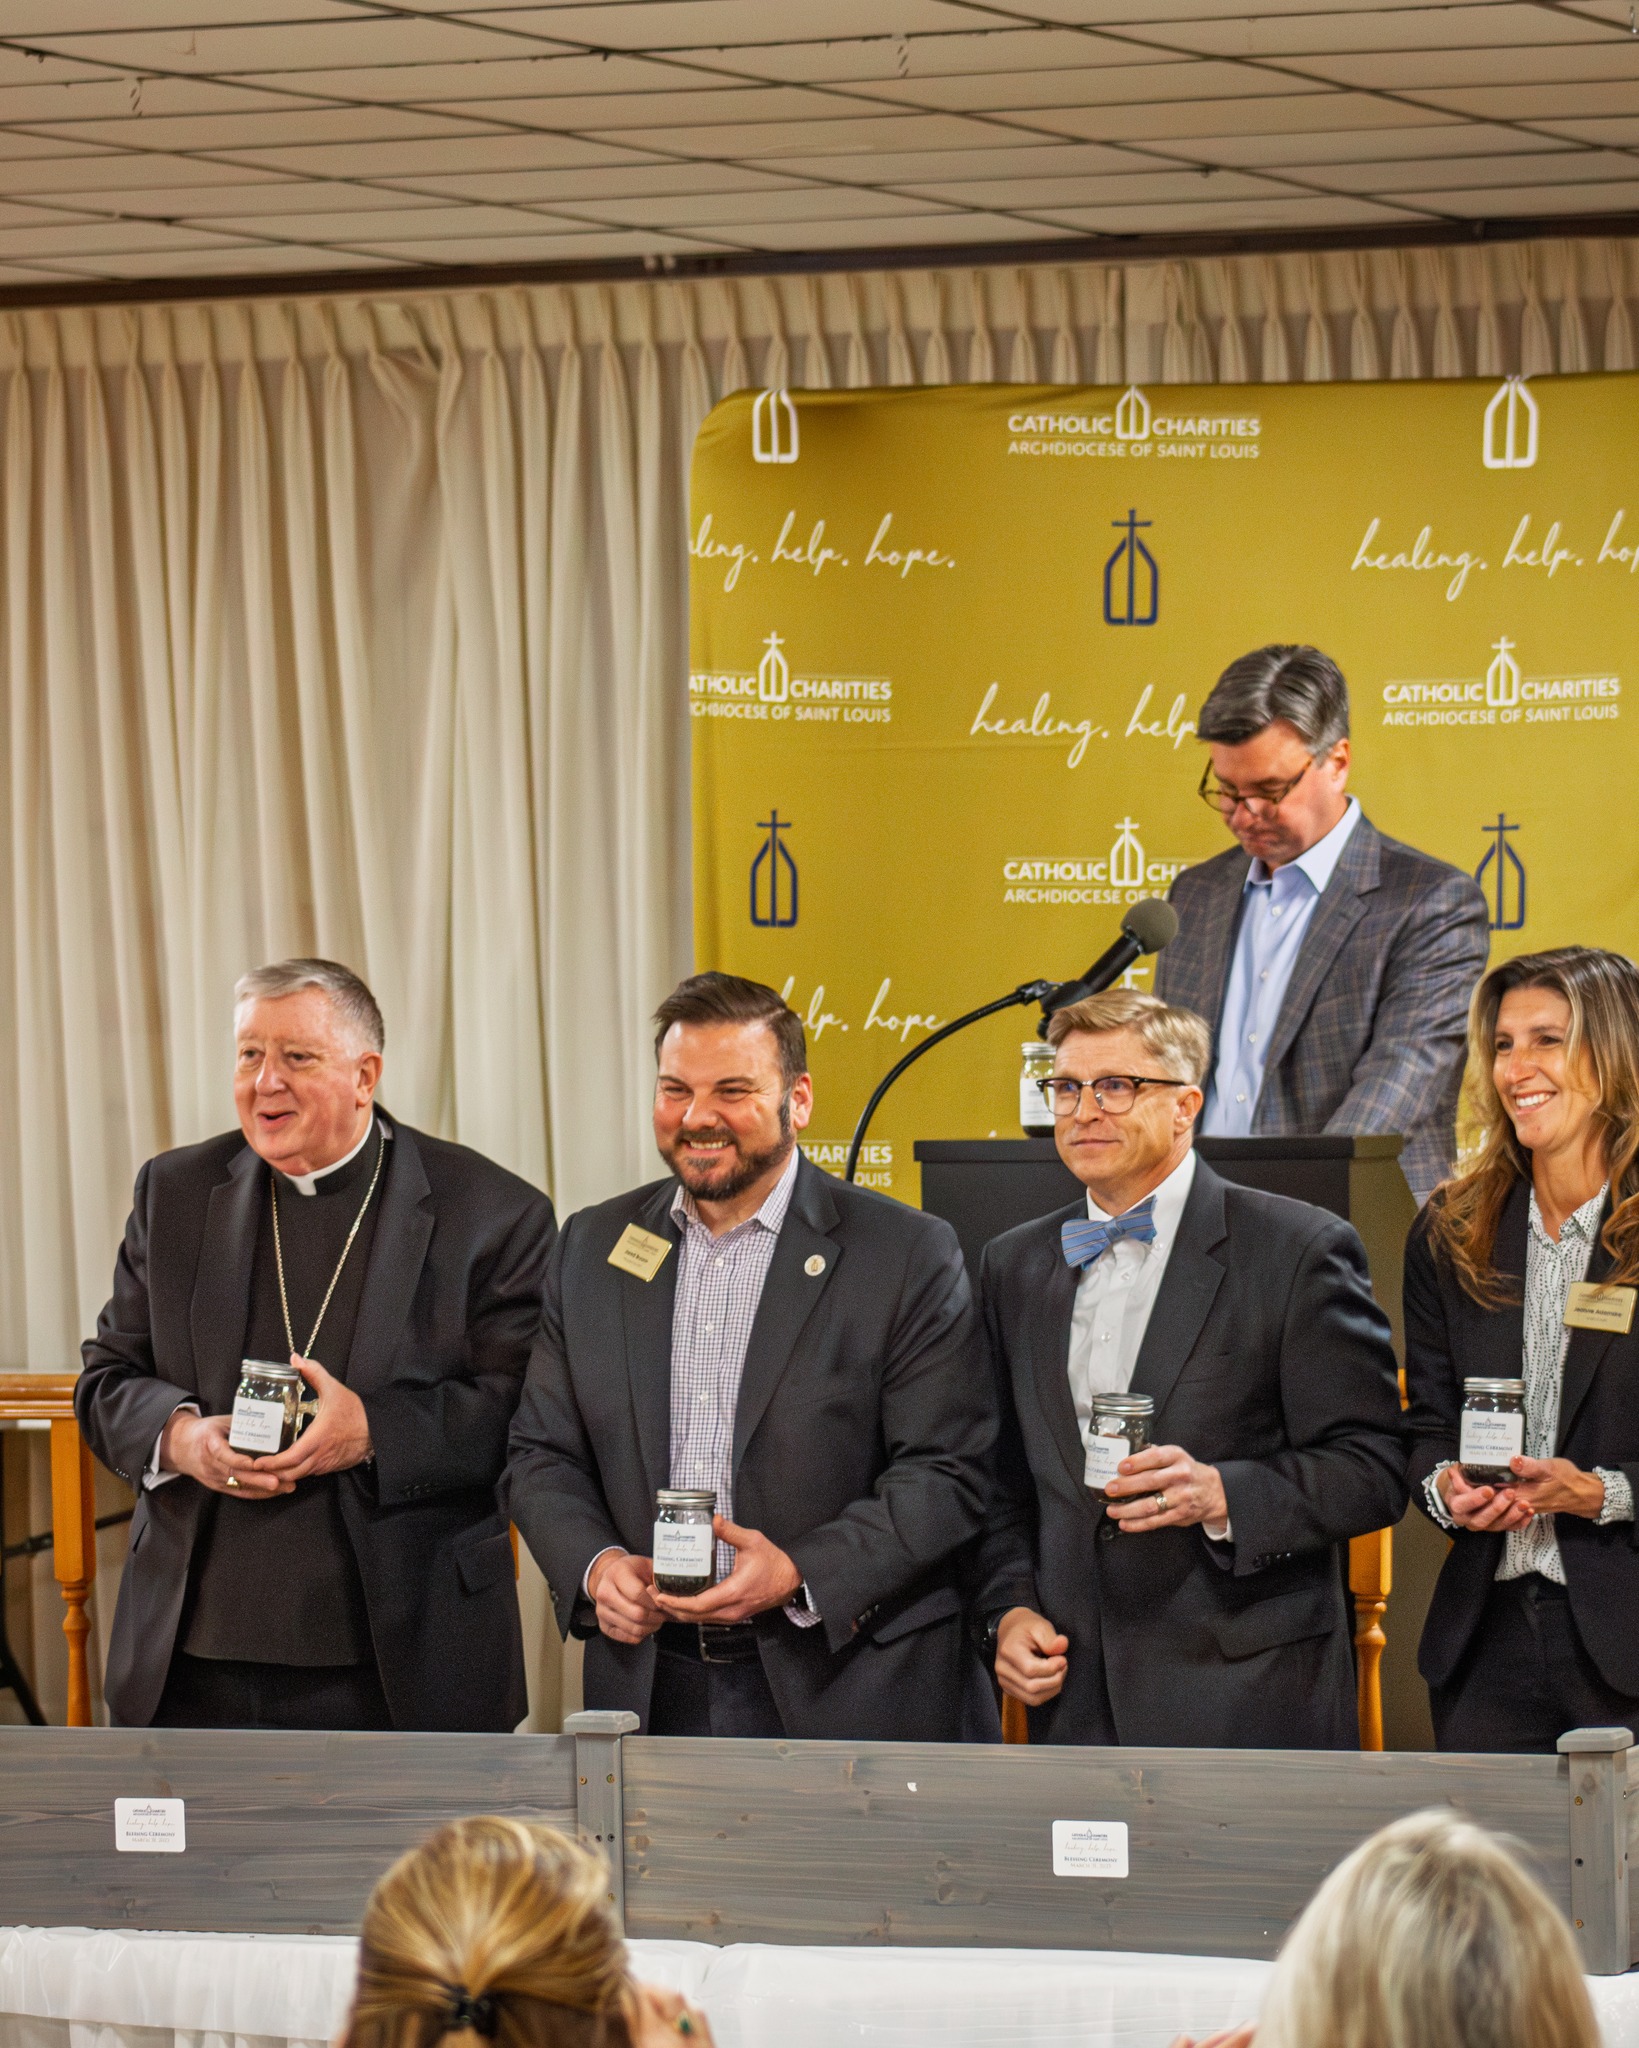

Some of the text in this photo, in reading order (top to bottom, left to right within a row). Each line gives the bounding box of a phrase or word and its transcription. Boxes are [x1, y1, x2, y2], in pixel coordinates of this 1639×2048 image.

[1008, 415, 1261, 437] CATHOLIC CHARITIES
[1007, 441, 1260, 459] ARCHDIOCESE OF SAINT LOUIS
[771, 510, 849, 577] help.
[864, 512, 956, 579] hope.
[1351, 516, 1489, 602] healing.
[1502, 513, 1584, 579] help.
[790, 680, 893, 700] CHARITIES
[1382, 677, 1620, 703] CATHOLIC CHARITIES
[771, 705, 790, 720] OF
[795, 706, 840, 722] SAINT
[843, 707, 892, 723] LOUIS
[1382, 704, 1619, 727] ARCHDIOCESE OF SAINT LOUIS
[970, 682, 1110, 769] healing.
[1003, 862, 1107, 882] CATHOLIC
[1003, 888, 1121, 905] ARCHDIOCESE
[853, 1171, 893, 1188] OUIS
